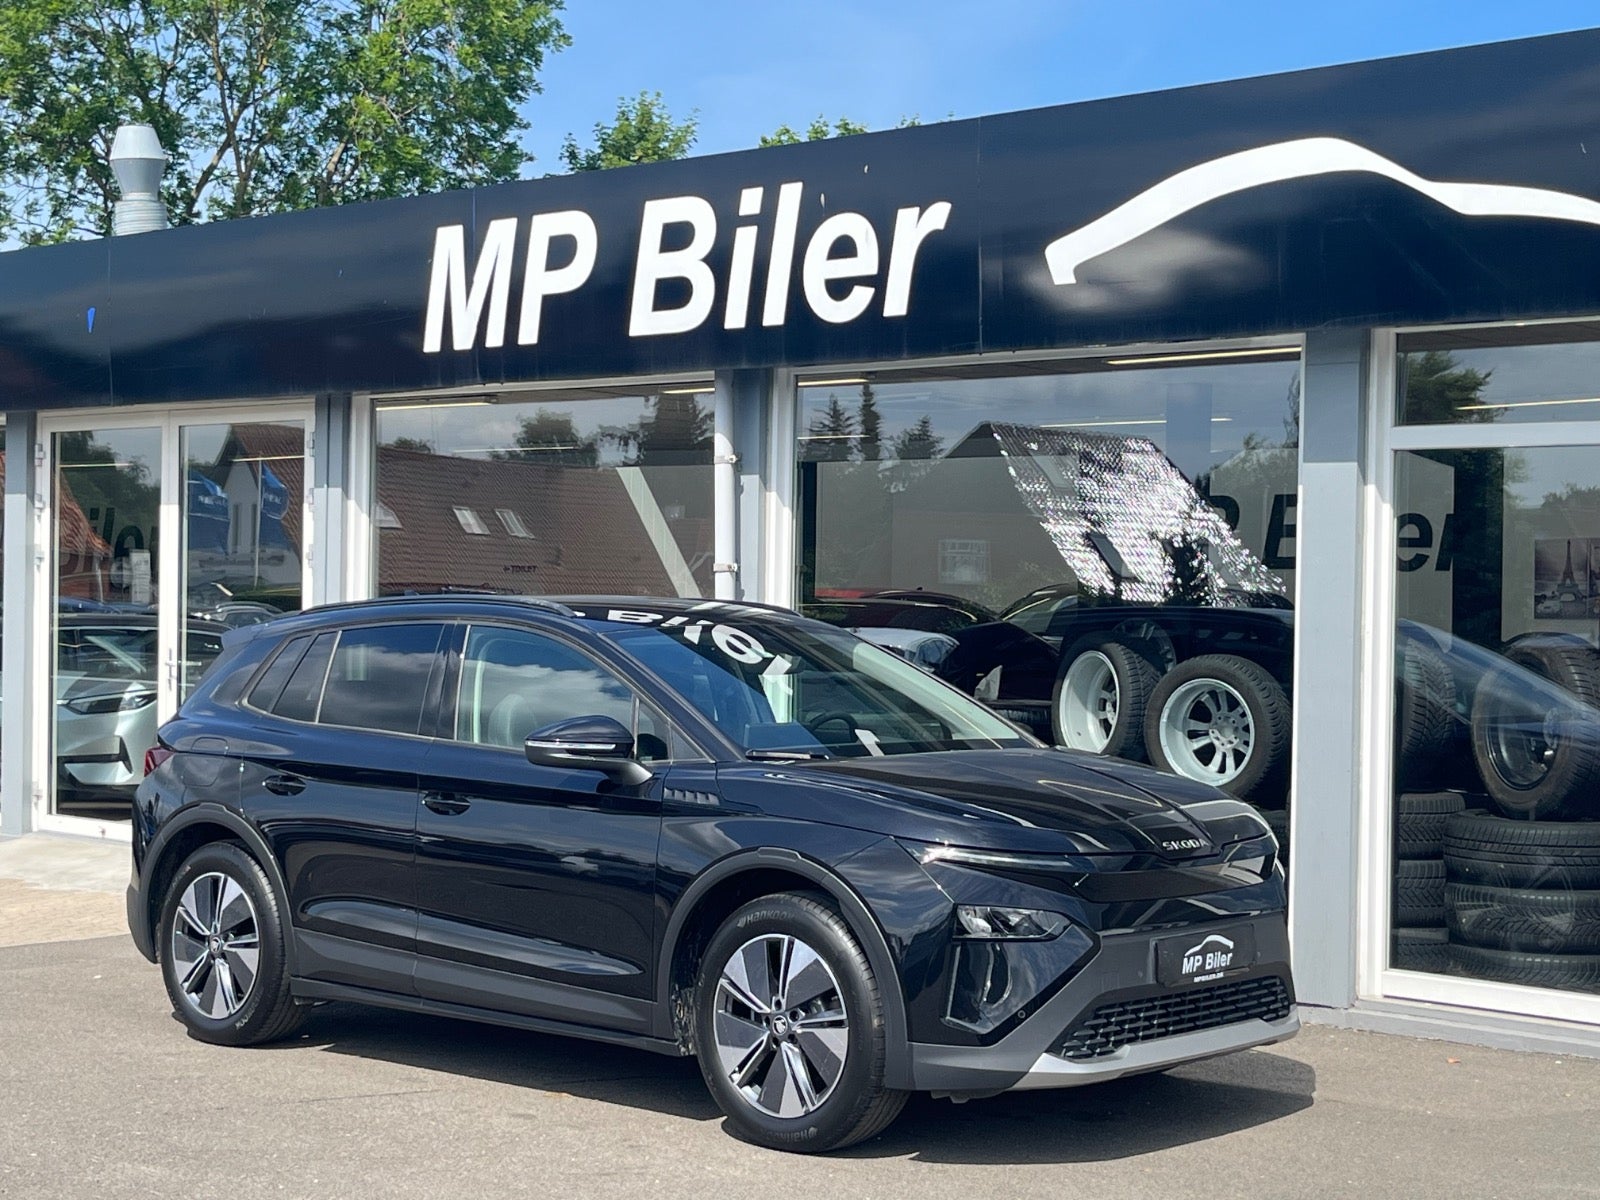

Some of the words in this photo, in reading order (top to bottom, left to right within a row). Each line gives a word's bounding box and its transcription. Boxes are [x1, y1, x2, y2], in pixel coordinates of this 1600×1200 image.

[423, 210, 598, 353] MP
[628, 181, 952, 337] Biler
[1182, 955, 1202, 974] MP
[1205, 951, 1233, 970] Biler
